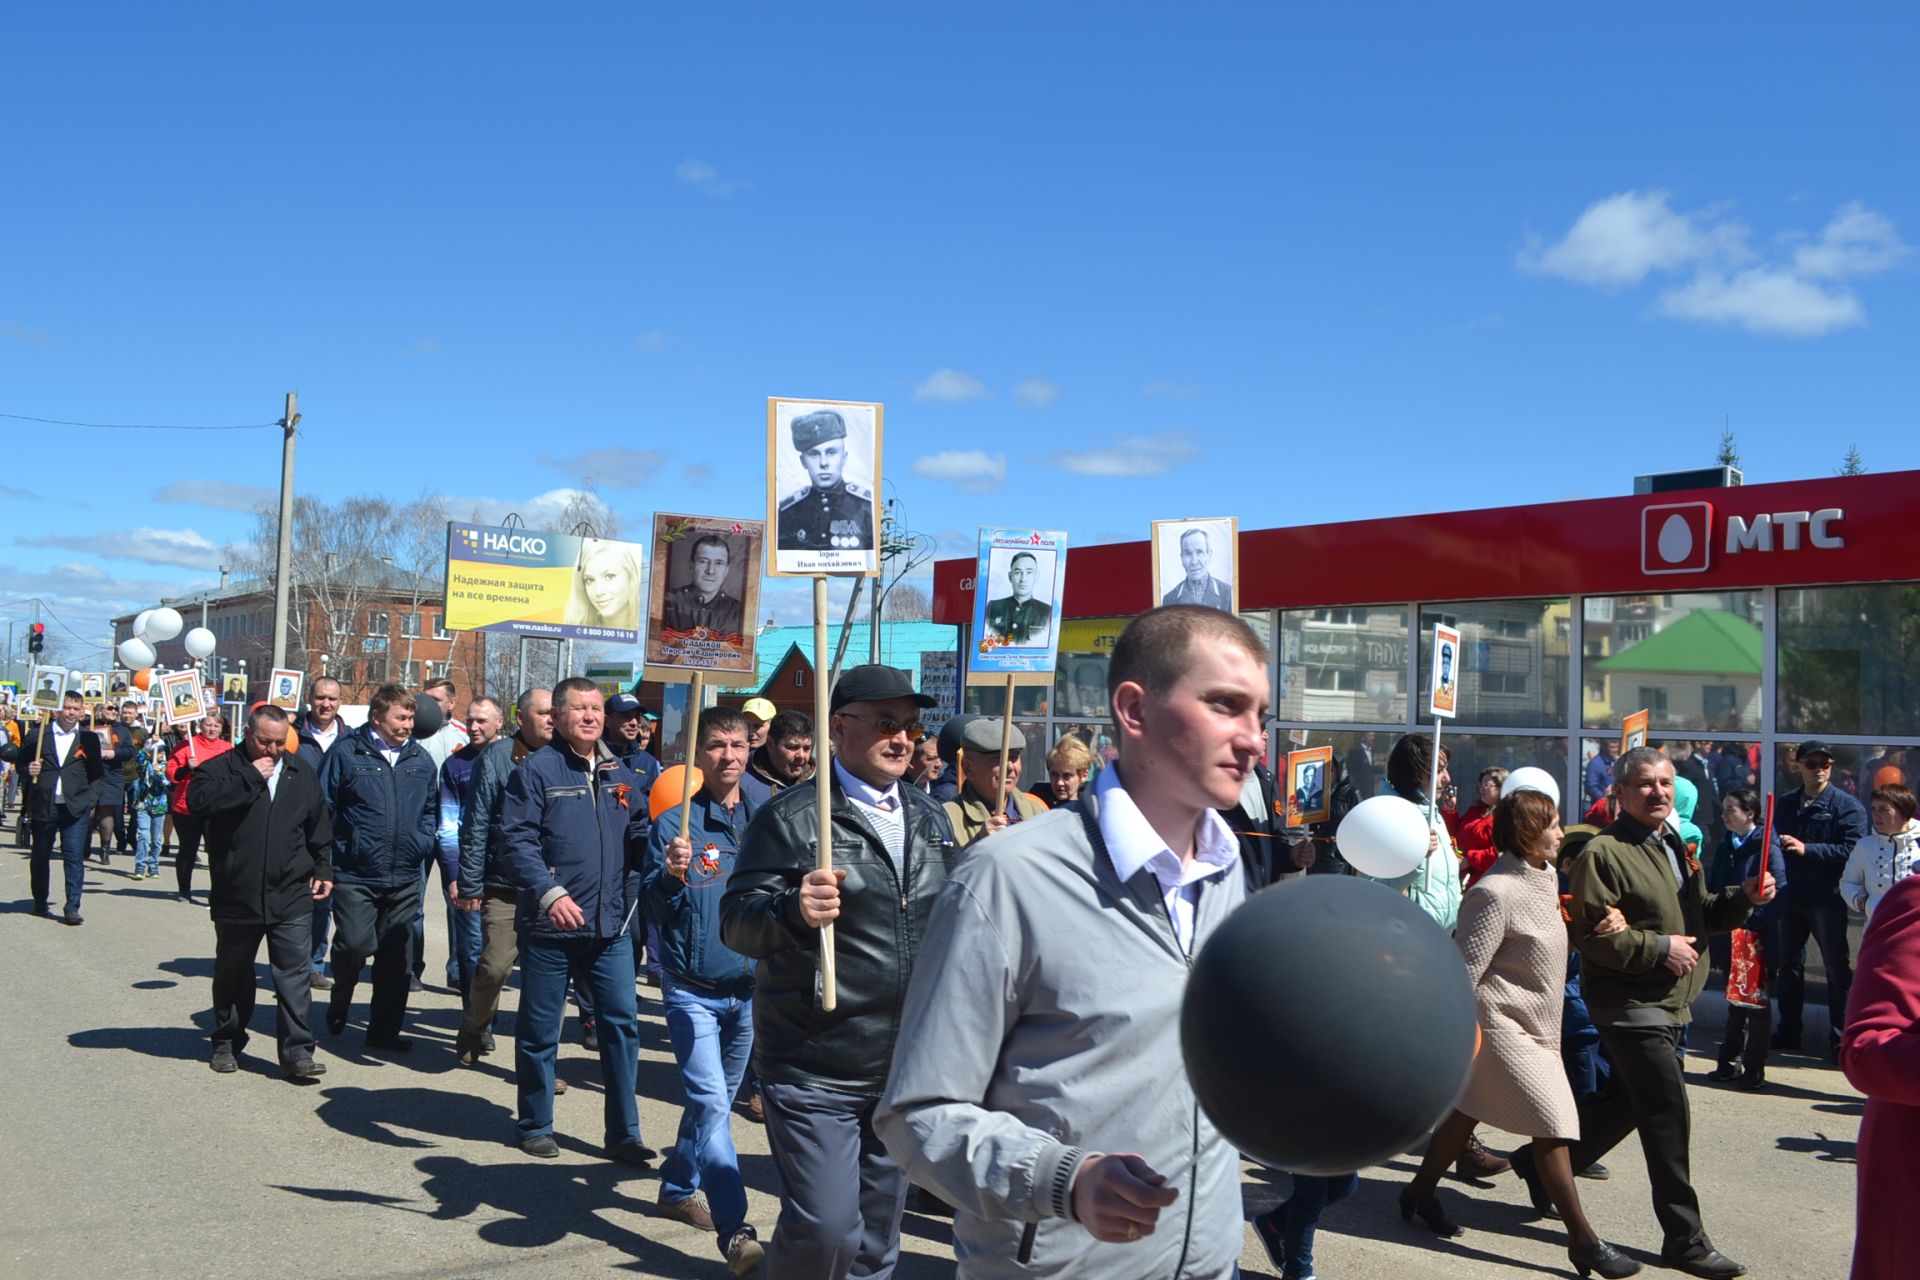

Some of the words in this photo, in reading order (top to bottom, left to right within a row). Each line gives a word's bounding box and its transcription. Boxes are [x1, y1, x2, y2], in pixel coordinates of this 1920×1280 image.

[1725, 508, 1844, 553] МТС
[483, 532, 547, 555] НАСКО
[797, 560, 816, 568] Иван
[453, 574, 506, 588] Надежная
[508, 582, 544, 592] защита
[467, 592, 484, 600] все
[486, 593, 530, 604] времена
[512, 623, 562, 633] www.nasko.ru
[588, 628, 601, 636] 800
[602, 629, 615, 637] 500
[616, 630, 625, 638] 16
[625, 631, 634, 639] 16
[683, 639, 721, 649] Садыков
